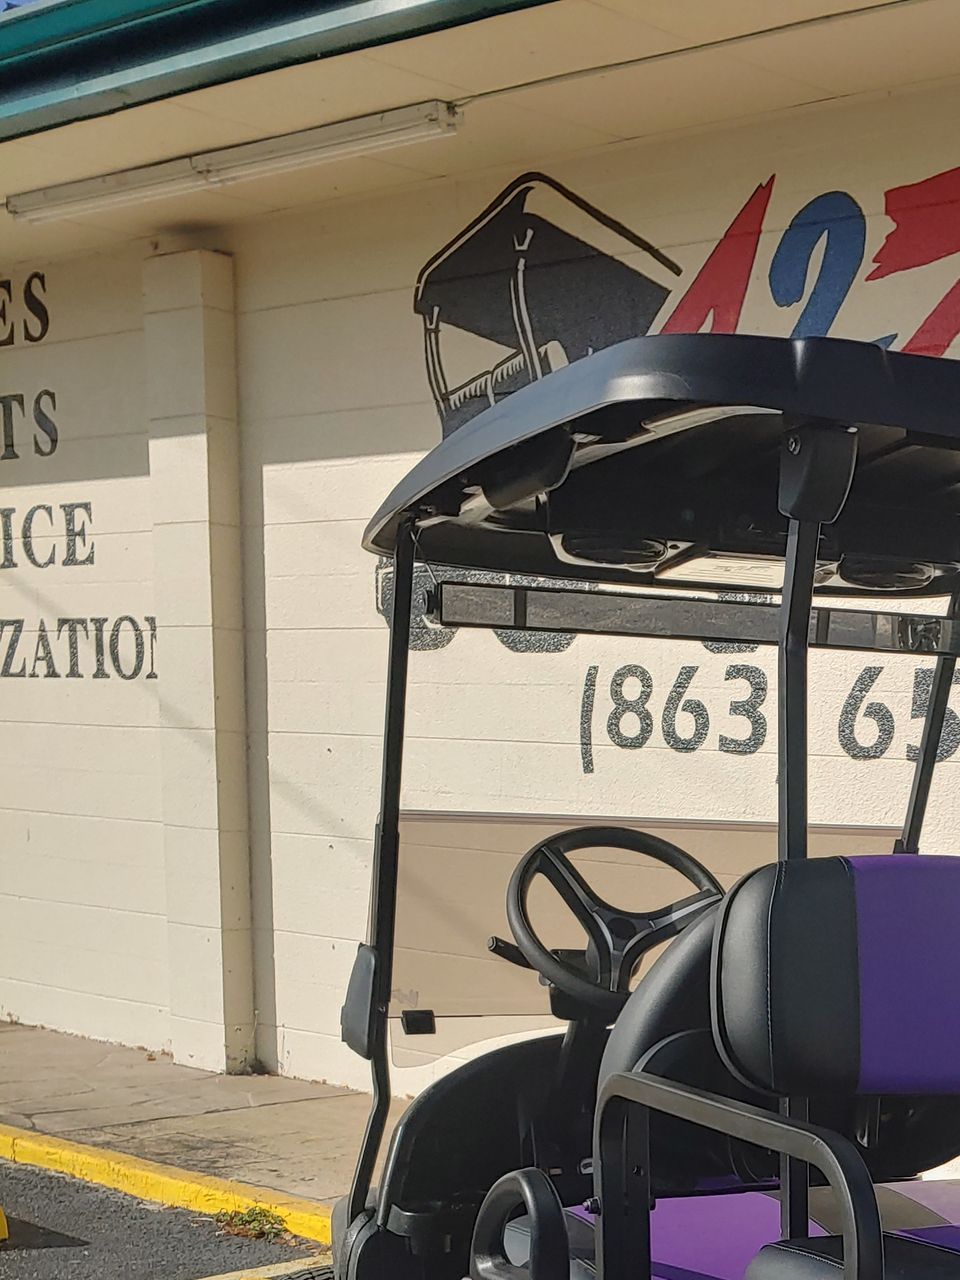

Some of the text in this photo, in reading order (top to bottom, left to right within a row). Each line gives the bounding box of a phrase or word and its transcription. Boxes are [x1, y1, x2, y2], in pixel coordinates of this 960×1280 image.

[0, 389, 58, 460] TS
[0, 501, 95, 569] ICE
[579, 663, 780, 785] (863
